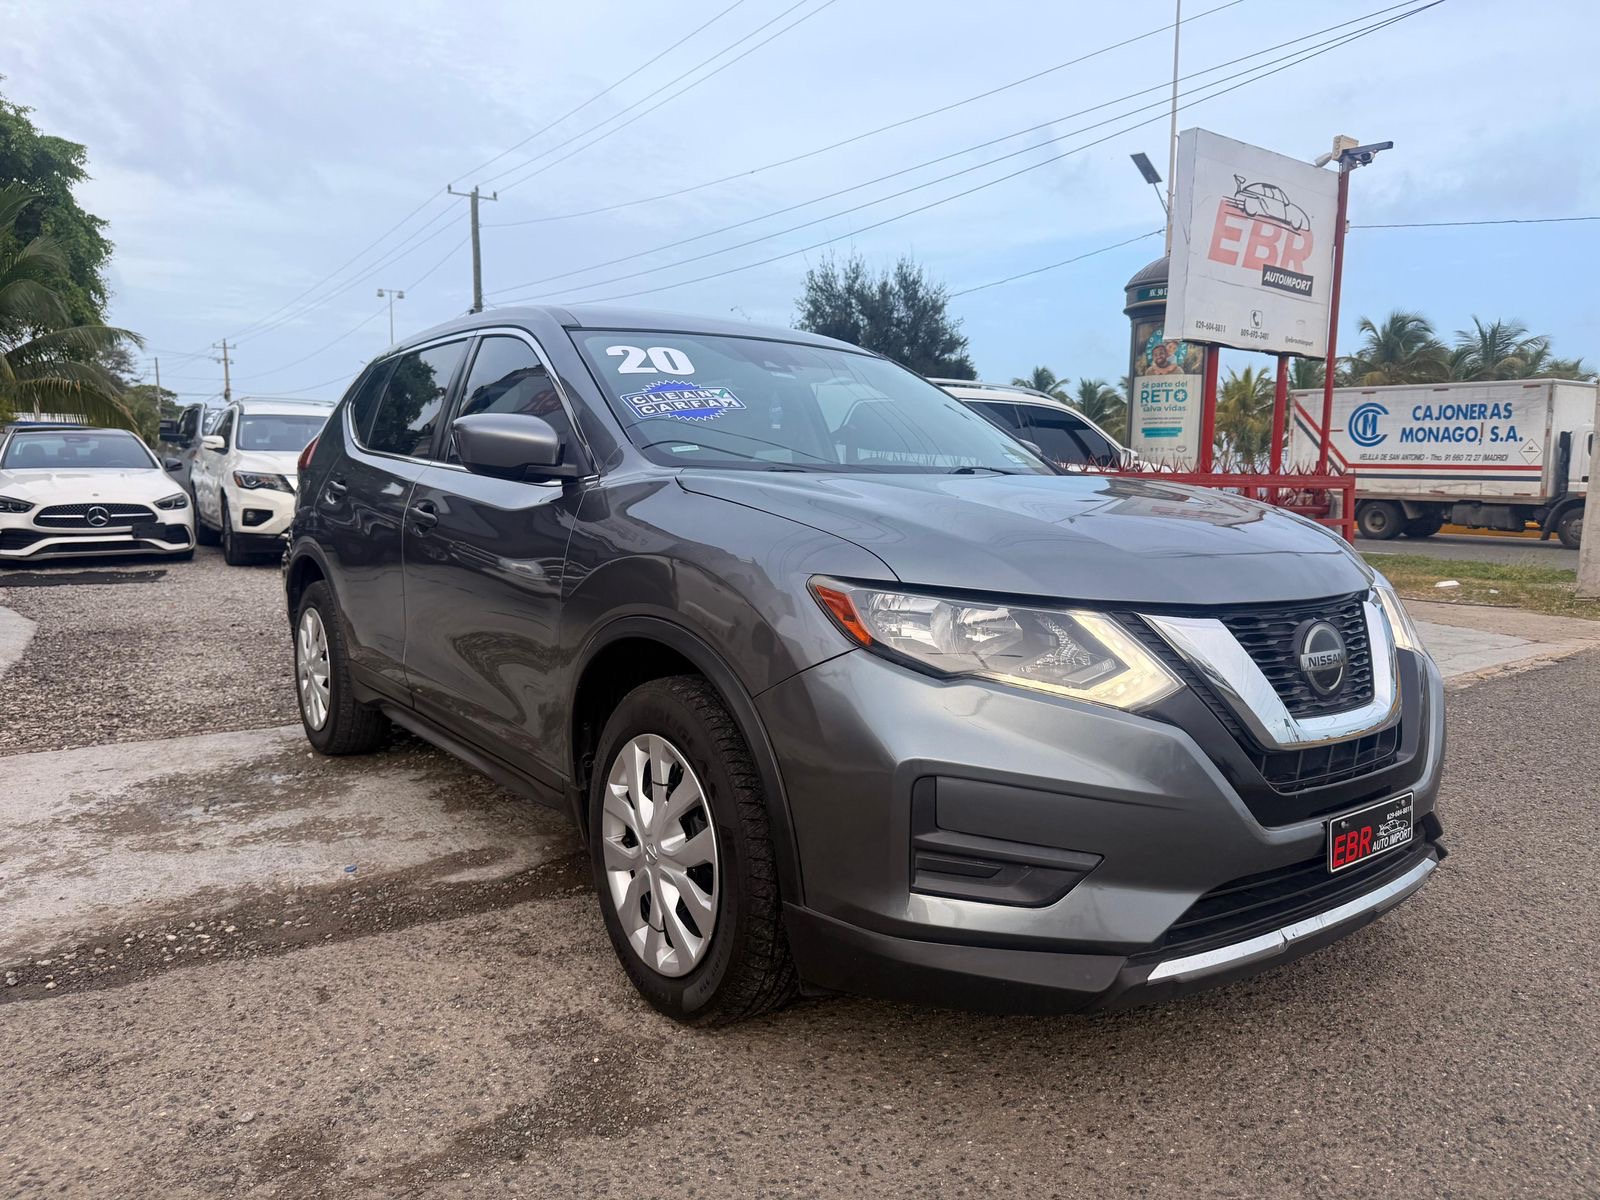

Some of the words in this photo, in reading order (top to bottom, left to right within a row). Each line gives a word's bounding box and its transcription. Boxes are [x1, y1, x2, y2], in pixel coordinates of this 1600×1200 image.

[1208, 198, 1314, 273] EBR
[1263, 270, 1312, 291] AUTOIMPORT
[606, 345, 695, 376] 20
[1175, 380, 1188, 388] del
[631, 389, 713, 405] CLEAN
[1140, 389, 1188, 404] RETO
[640, 399, 739, 414] CARFAX
[1164, 404, 1186, 412] vidas
[1412, 402, 1513, 422] CAJONERAS
[1489, 425, 1524, 442] S.A.
[1380, 453, 1388, 461] DE
[1388, 453, 1400, 461] SAN
[1401, 453, 1425, 461] ANTONIO
[1332, 825, 1373, 868] EBR
[1372, 836, 1389, 853] AUTO
[1389, 827, 1412, 844] IMPORT
